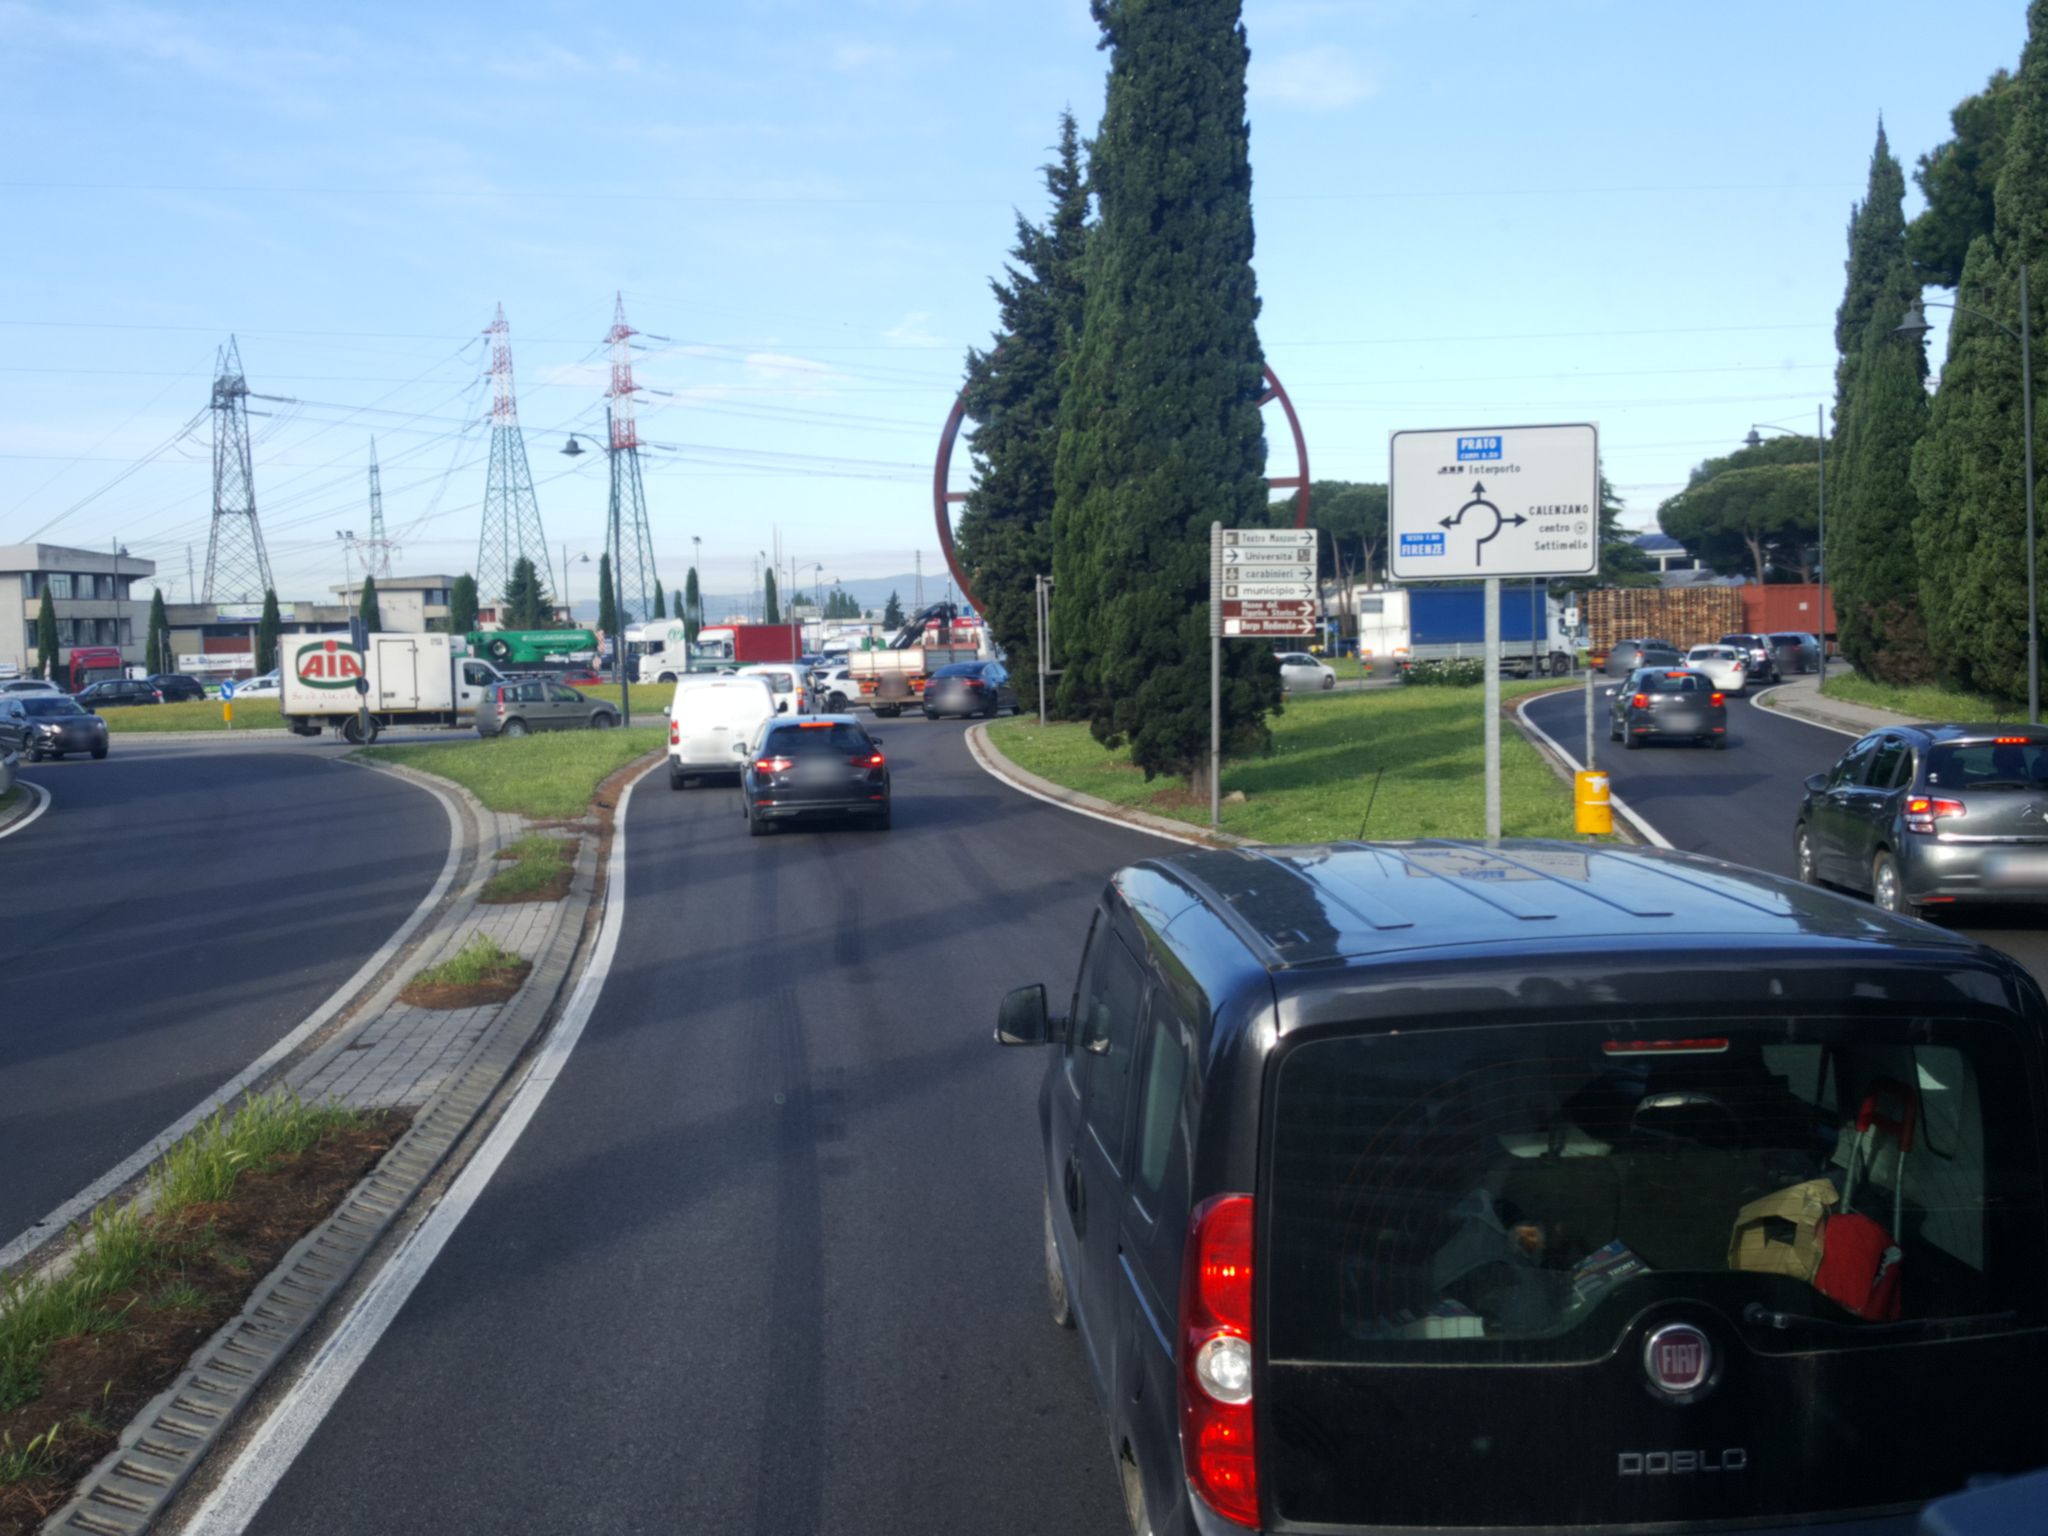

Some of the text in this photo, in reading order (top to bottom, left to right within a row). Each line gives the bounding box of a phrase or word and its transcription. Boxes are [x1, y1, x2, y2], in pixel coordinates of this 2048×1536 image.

[1461, 438, 1497, 450] PRATO
[1469, 464, 1521, 475] Interporto
[1529, 504, 1589, 516] CALENZANO
[1539, 523, 1570, 533] centro
[1402, 544, 1443, 555] FIRENZE
[1534, 540, 1589, 551] Settimello
[1246, 570, 1293, 578] carabinieri
[1243, 587, 1295, 596] municipio
[1662, 1344, 1699, 1374] FIAT
[1618, 1448, 1746, 1476] DOBLO
